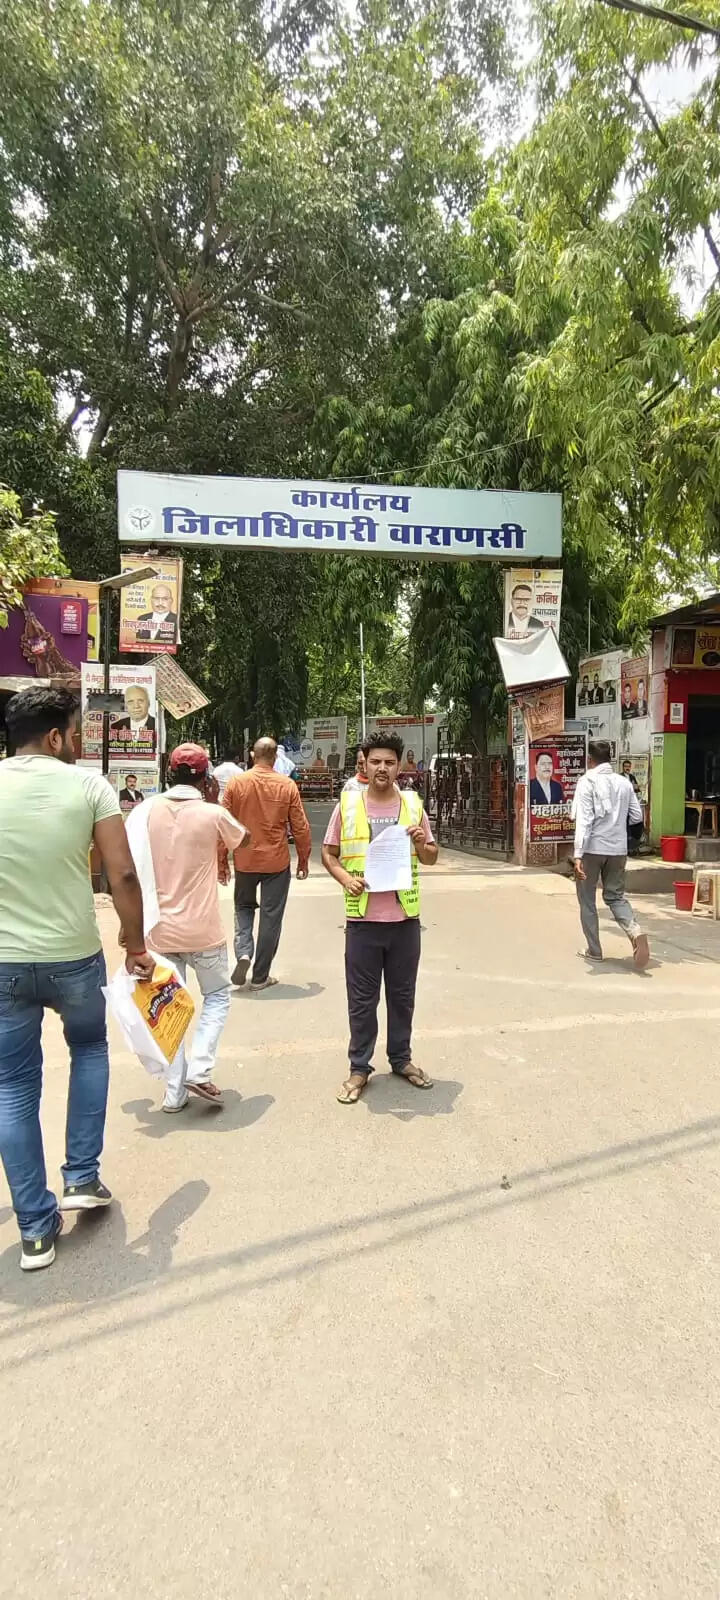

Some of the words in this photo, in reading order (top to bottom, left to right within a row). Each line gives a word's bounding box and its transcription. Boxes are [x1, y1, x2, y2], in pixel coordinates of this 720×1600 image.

[290, 486, 411, 513] कार्यालय
[161, 506, 379, 543] जिलाधिकारी
[388, 523, 527, 549] वाराणसी
[88, 713, 117, 722] 206
